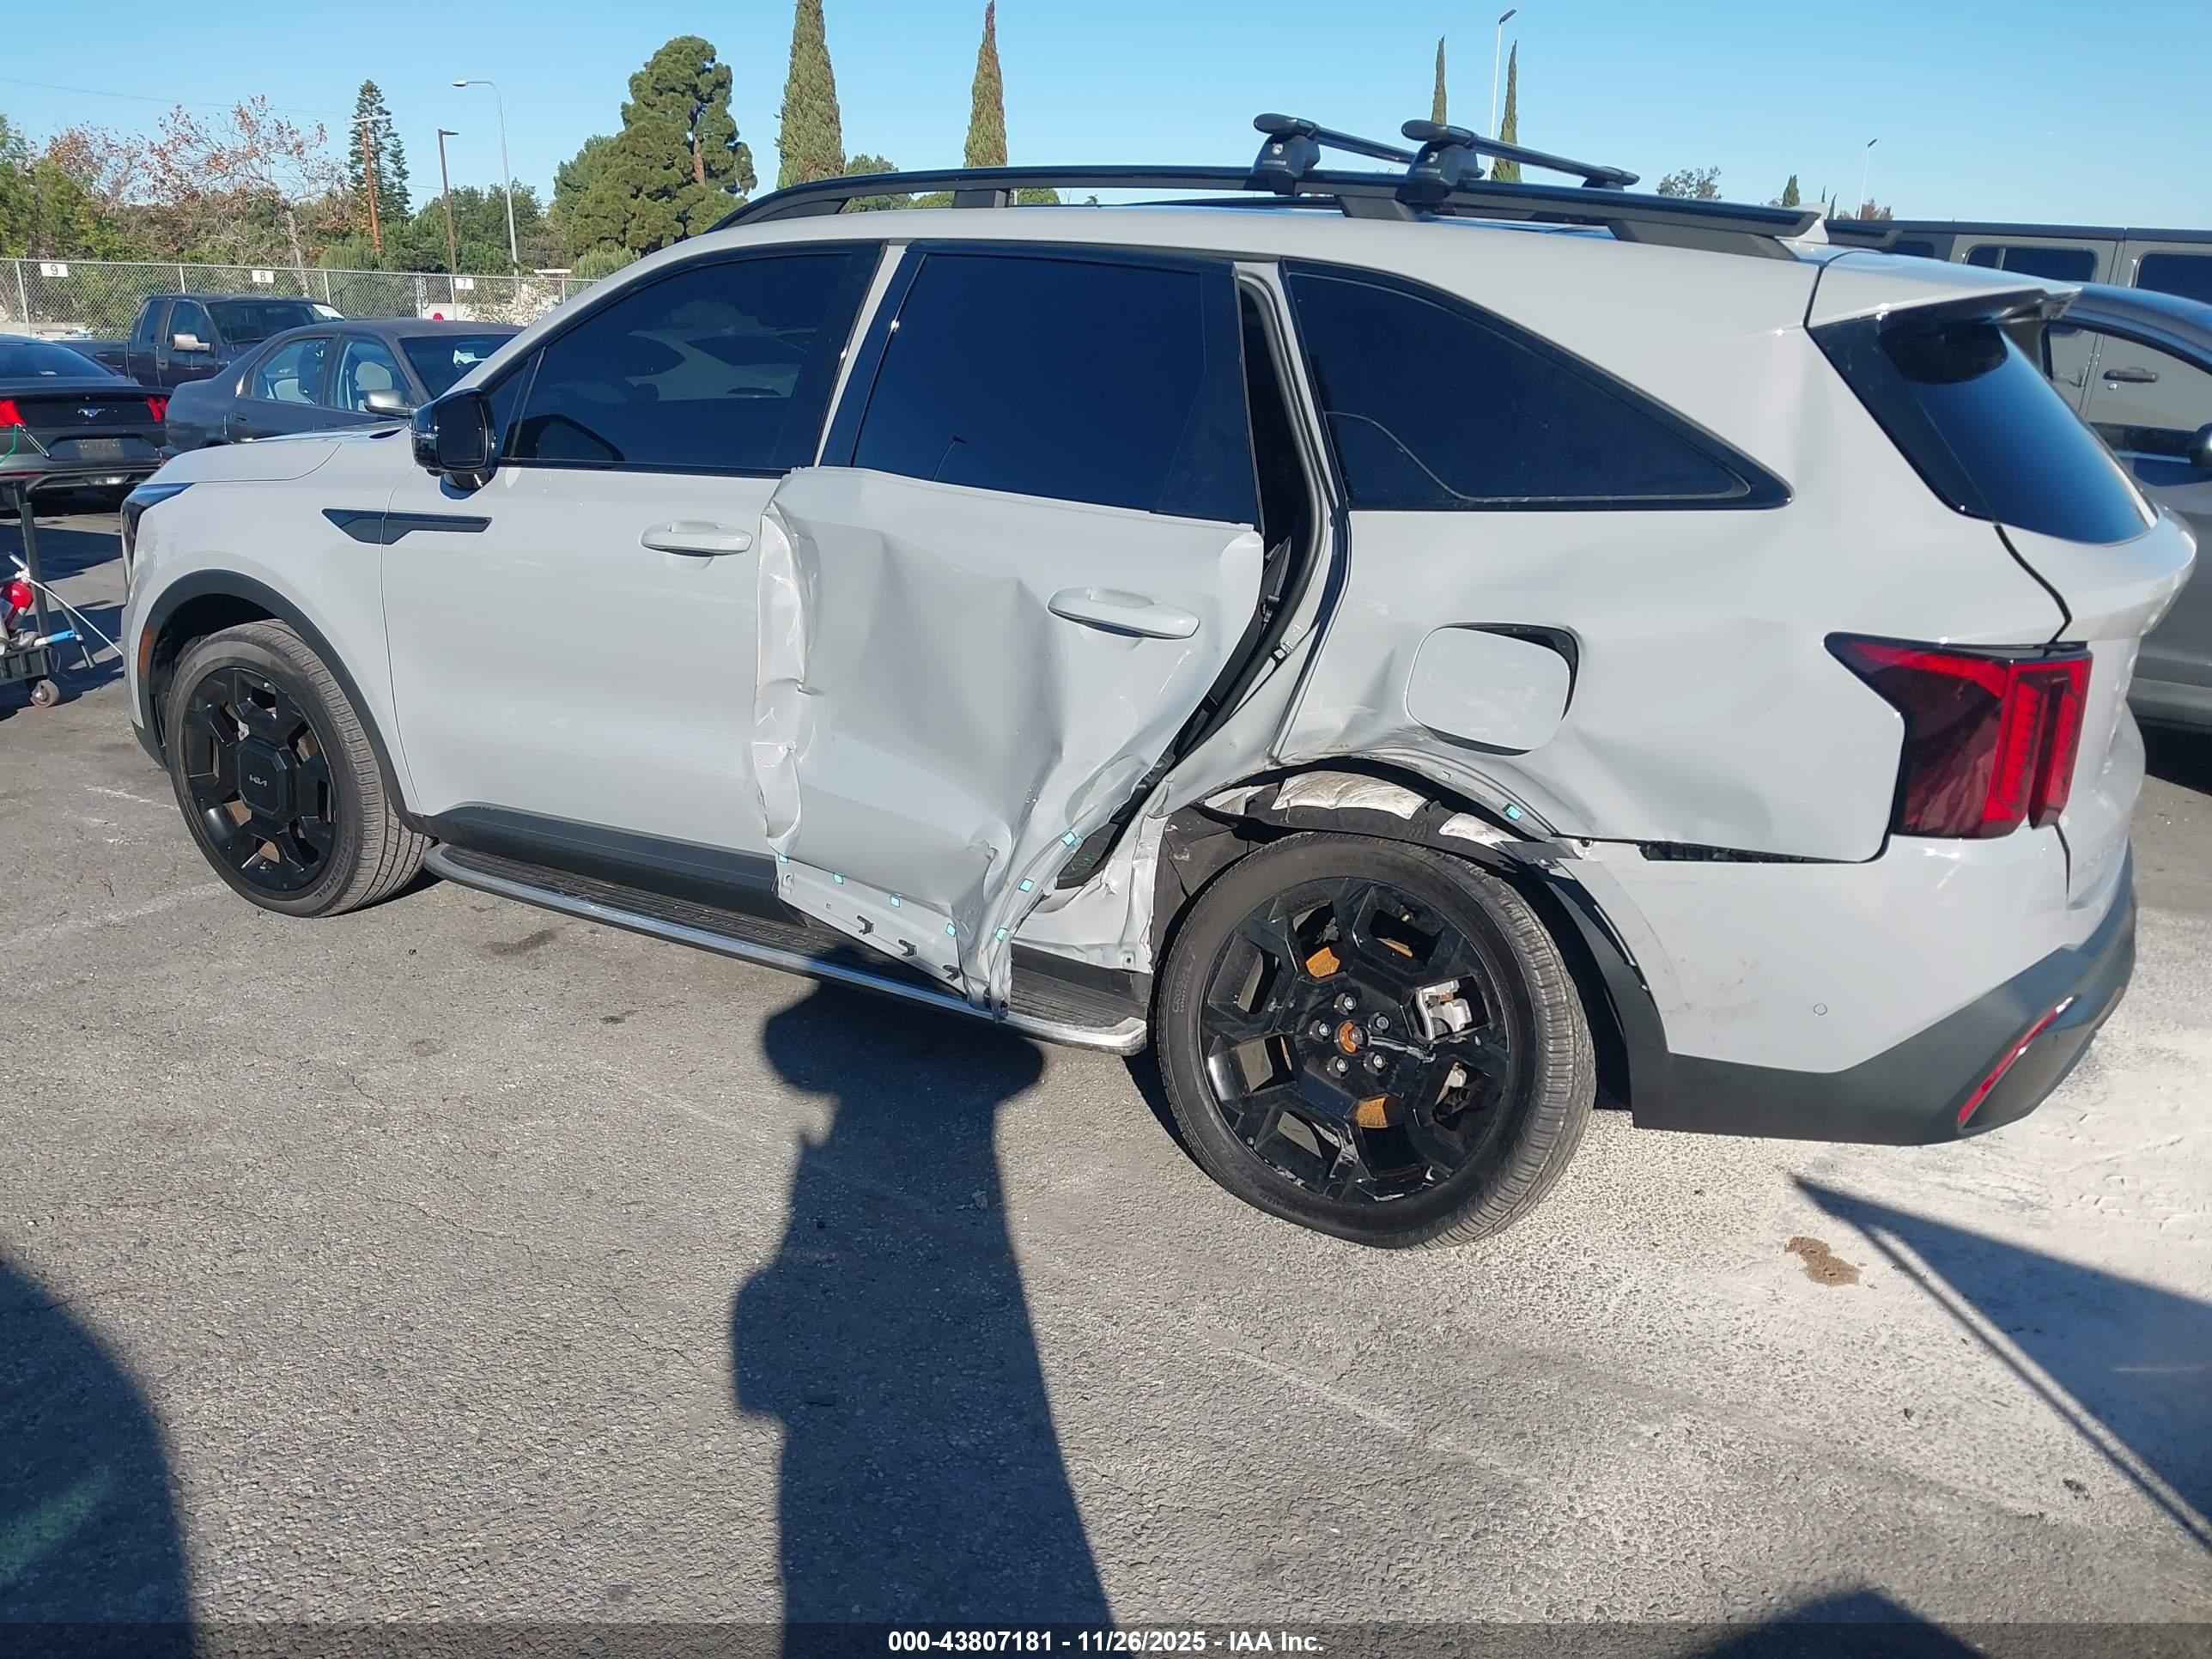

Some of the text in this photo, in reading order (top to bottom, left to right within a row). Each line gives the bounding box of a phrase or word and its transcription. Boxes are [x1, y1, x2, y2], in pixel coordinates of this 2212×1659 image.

[50, 264, 58, 276] 9
[259, 270, 266, 282] 8
[461, 278, 467, 289] 7
